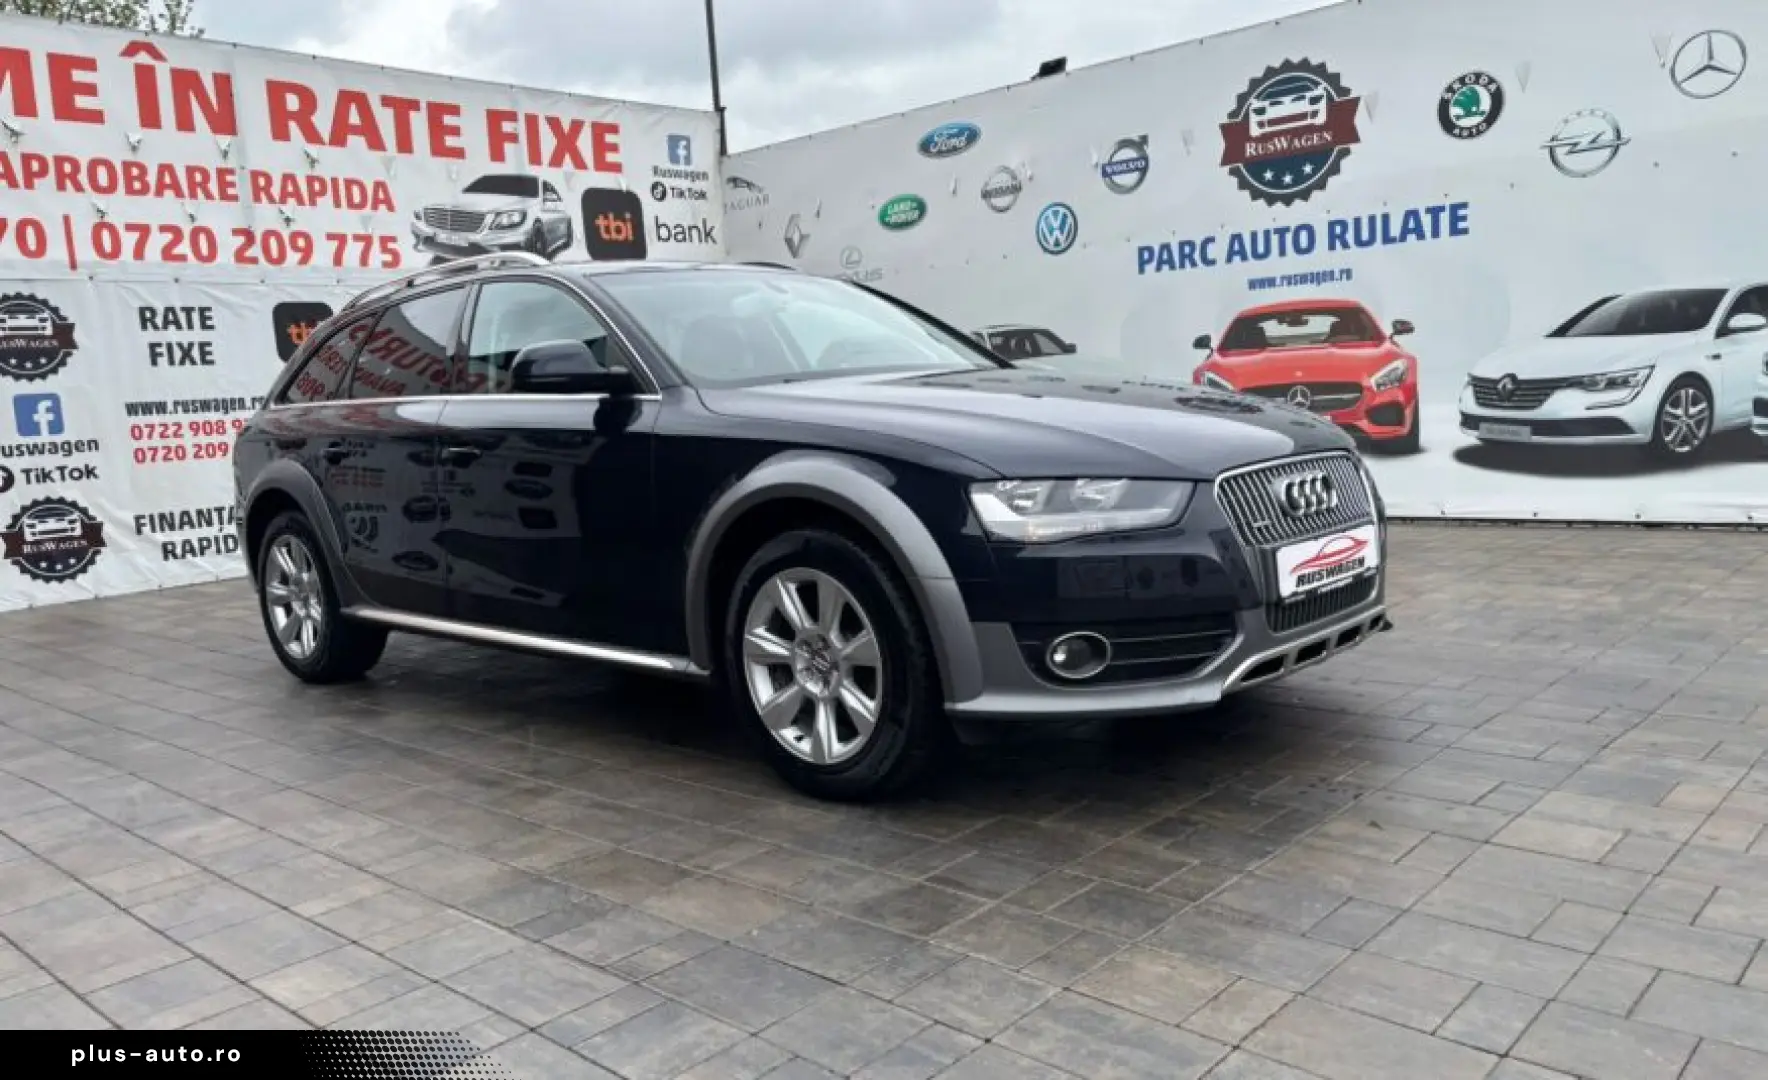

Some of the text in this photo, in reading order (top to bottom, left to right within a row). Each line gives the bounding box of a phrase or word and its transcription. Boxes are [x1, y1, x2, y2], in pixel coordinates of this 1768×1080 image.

[118, 39, 238, 136] ÎN
[265, 79, 466, 160] RATE
[485, 107, 623, 174] FIXE
[652, 165, 710, 182] Ruswagen
[1105, 159, 1146, 175] VOLVO
[249, 169, 397, 213] RAPIDA
[669, 186, 708, 201] TikTok
[594, 210, 718, 246] tbi bank
[1137, 201, 1471, 275] PARC AUTO RULATE
[0, 216, 48, 259] 0
[91, 221, 219, 264] 0720
[231, 226, 315, 266] 209
[325, 232, 403, 270] 775
[138, 305, 216, 331] RATE
[147, 341, 216, 367] FIXE
[130, 421, 184, 441] 0722
[189, 419, 228, 437] 908
[0, 438, 100, 458] uswagen
[133, 442, 229, 465] 0720 209
[20, 464, 100, 485] TikTok
[133, 506, 235, 536] FINANȚ
[161, 534, 239, 561] RAPID
